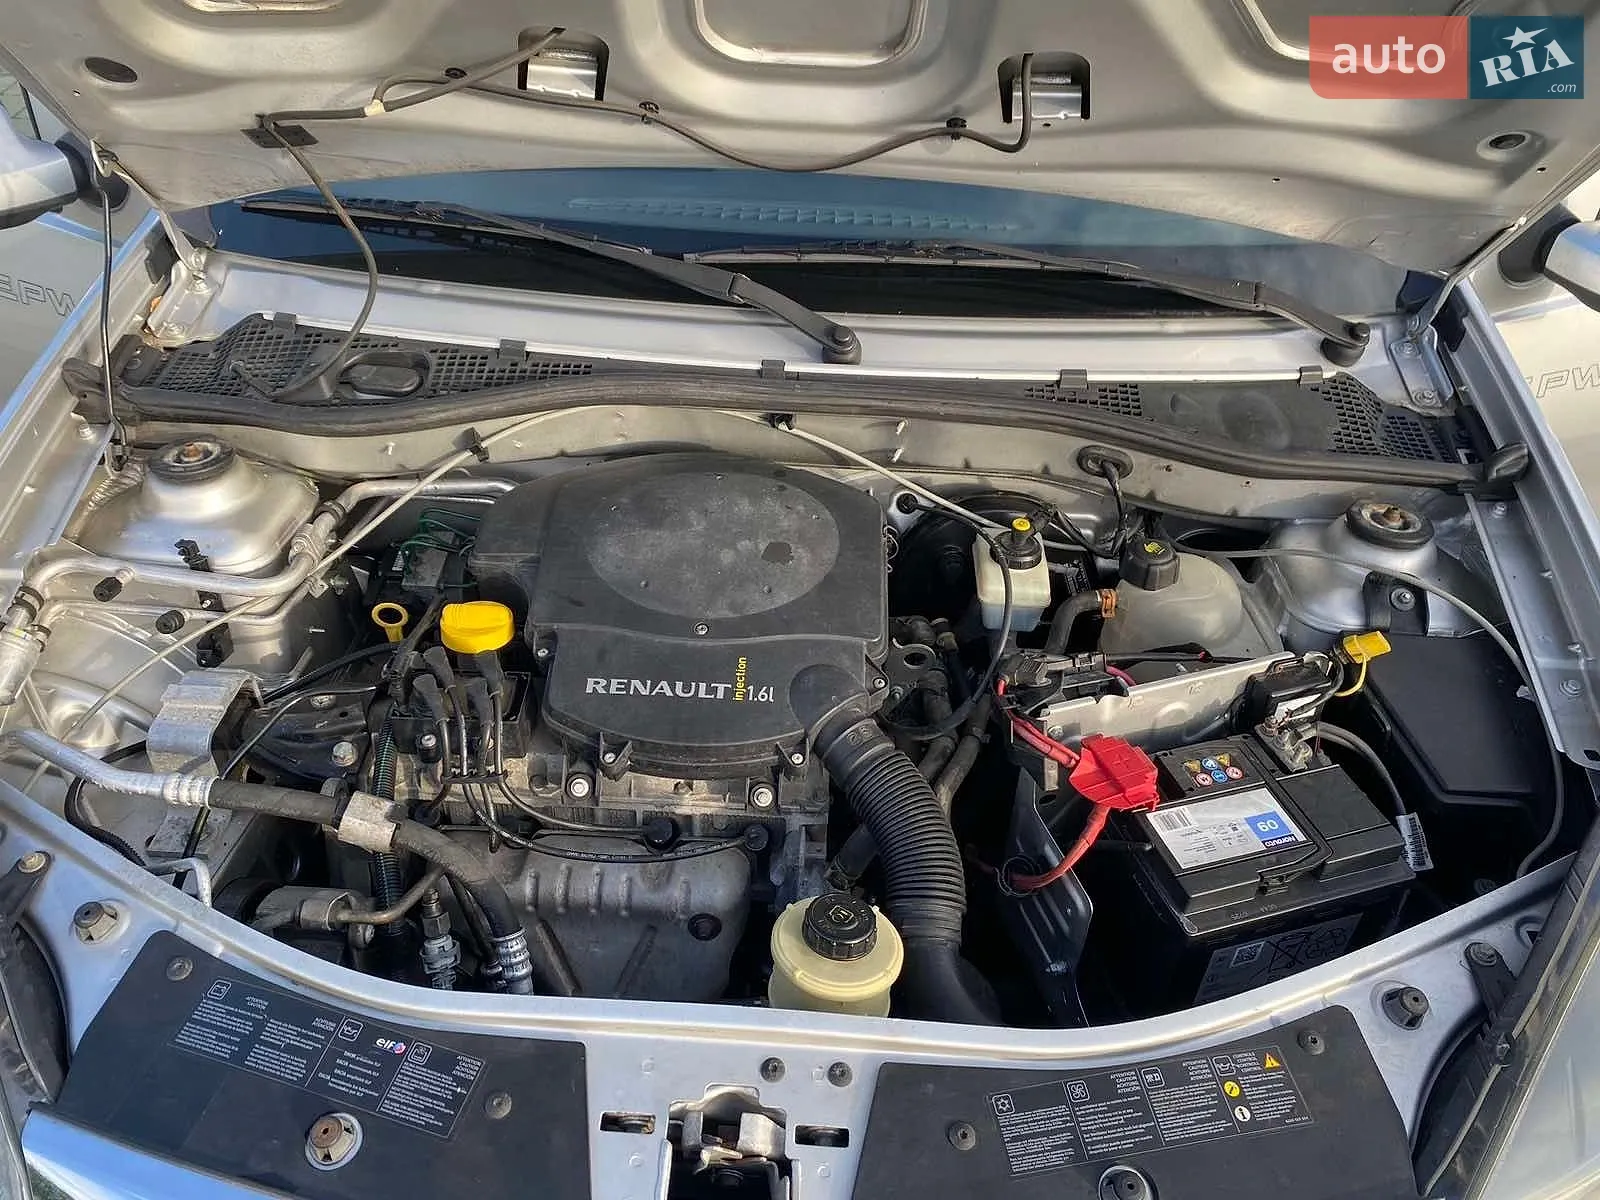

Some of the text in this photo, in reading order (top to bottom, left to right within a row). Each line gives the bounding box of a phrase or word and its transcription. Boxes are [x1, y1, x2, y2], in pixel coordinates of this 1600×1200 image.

[732, 656, 748, 701] injection
[585, 677, 732, 700] RENAULT
[1264, 835, 1296, 848] Norauto
[375, 1038, 396, 1049] elf
